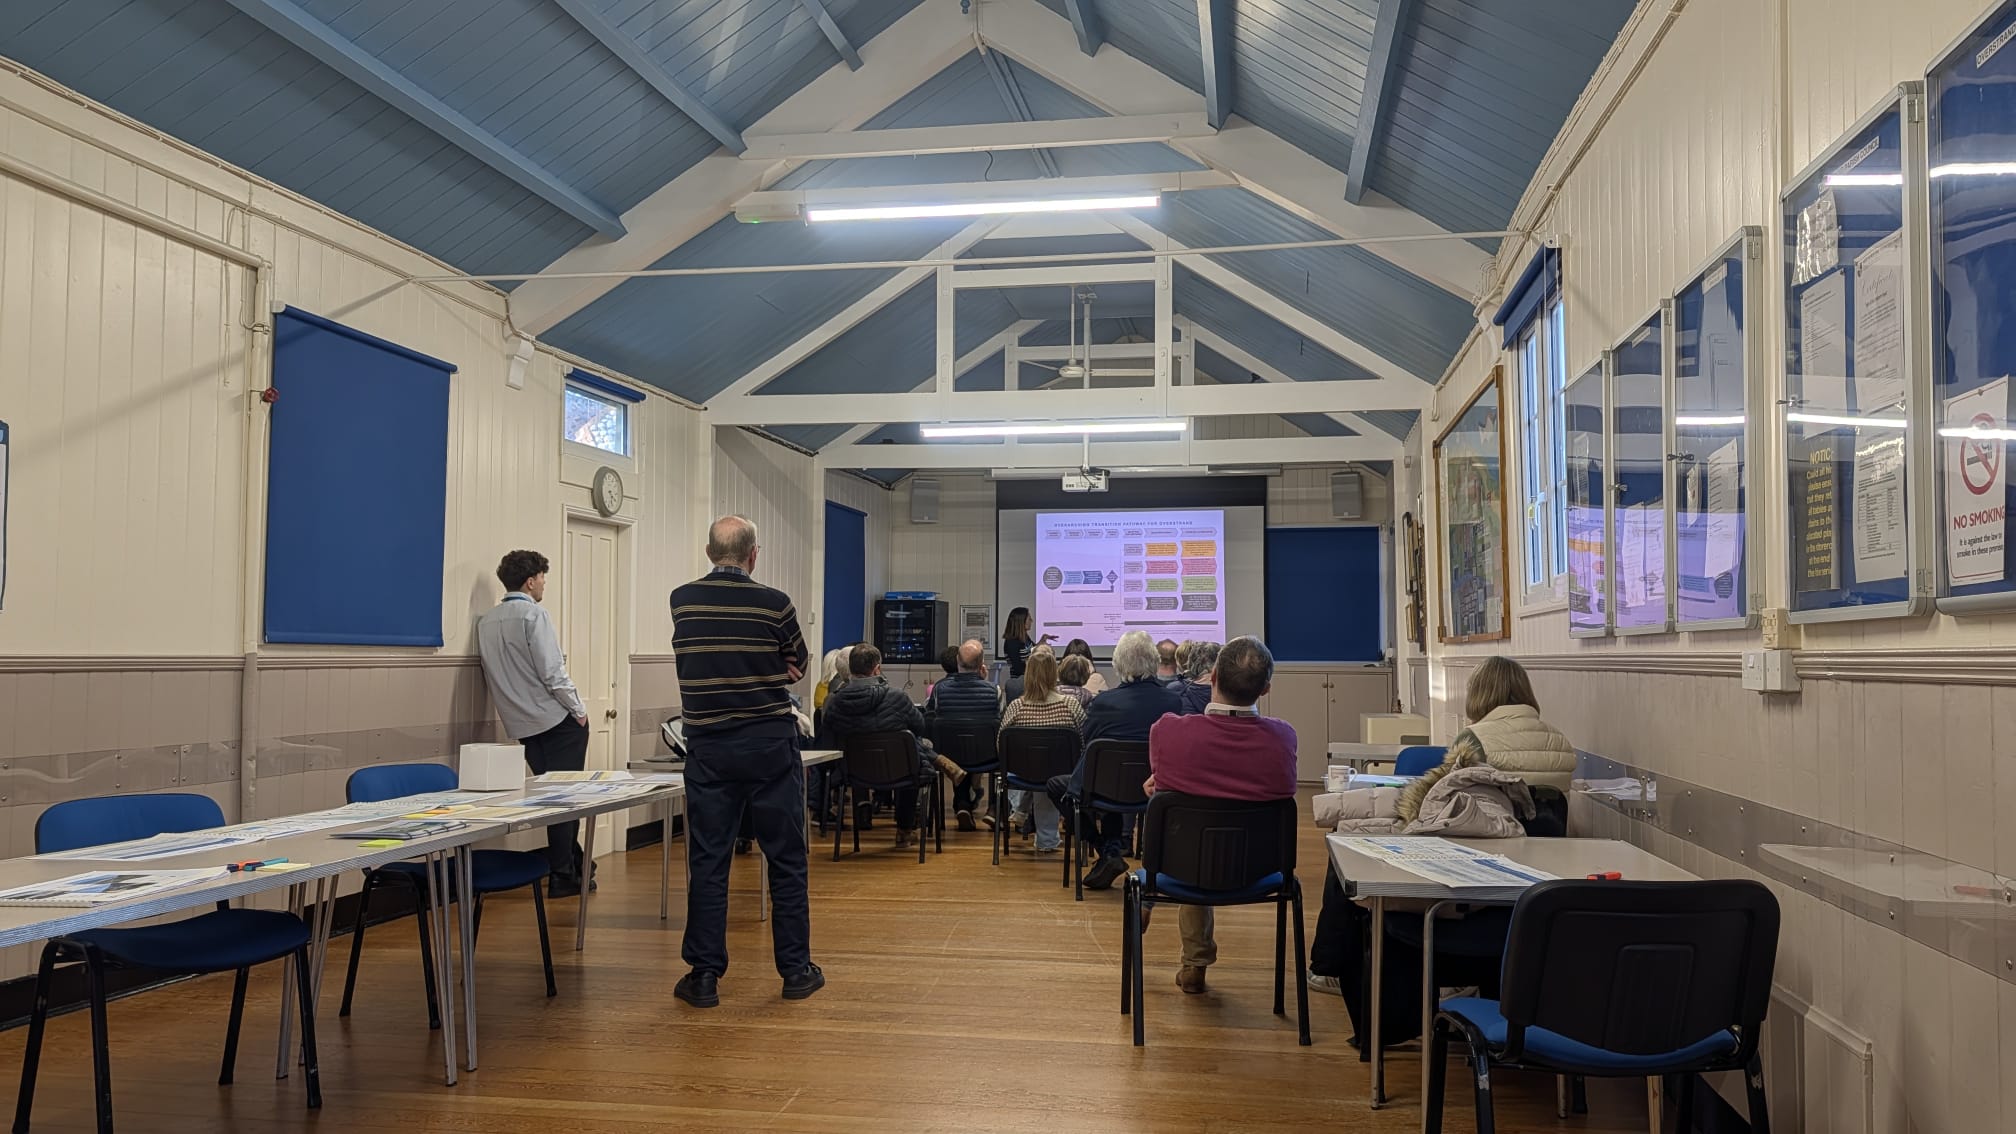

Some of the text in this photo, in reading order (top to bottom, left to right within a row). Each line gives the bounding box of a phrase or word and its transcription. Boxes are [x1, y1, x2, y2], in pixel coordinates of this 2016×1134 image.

[1860, 138, 1878, 160] COUNCIL
[1953, 515, 1968, 530] NO
[1968, 535, 1983, 547] against
[1977, 546, 1988, 555] these
